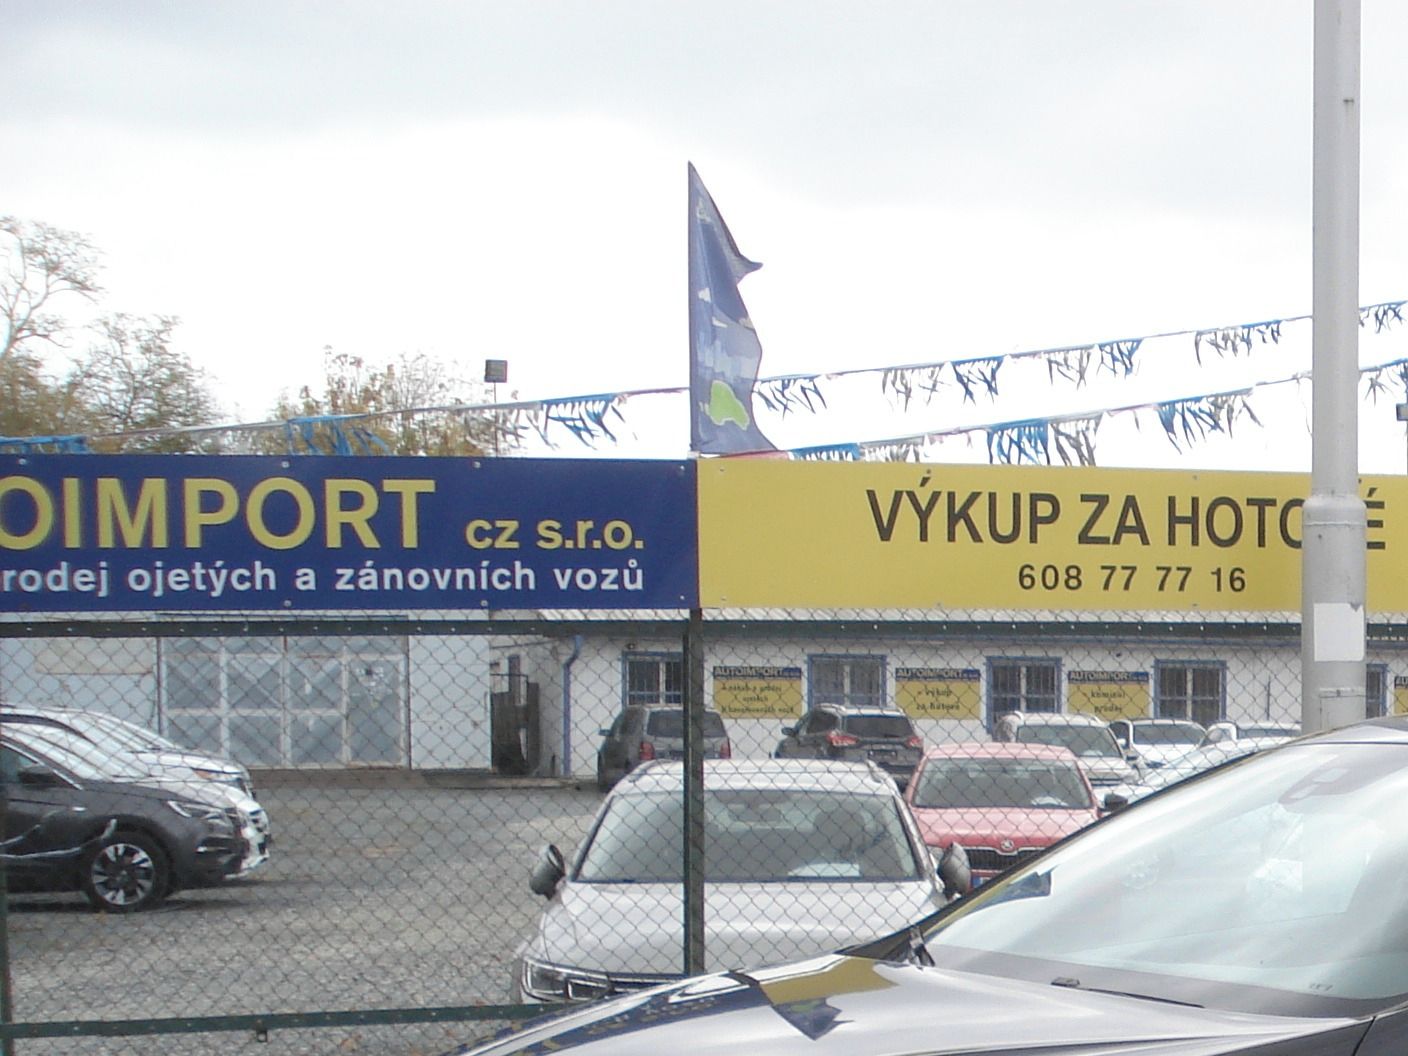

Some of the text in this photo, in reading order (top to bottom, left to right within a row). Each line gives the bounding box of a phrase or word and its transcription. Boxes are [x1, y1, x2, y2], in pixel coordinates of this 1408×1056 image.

[0, 475, 645, 550] OIMPORT cz s.r.o.
[865, 476, 1387, 550] VÝKUP ZA HOTOÉ
[2, 558, 644, 598] rodej ojetých a zánovních vozů
[1018, 563, 1247, 593] 608 77 77 16
